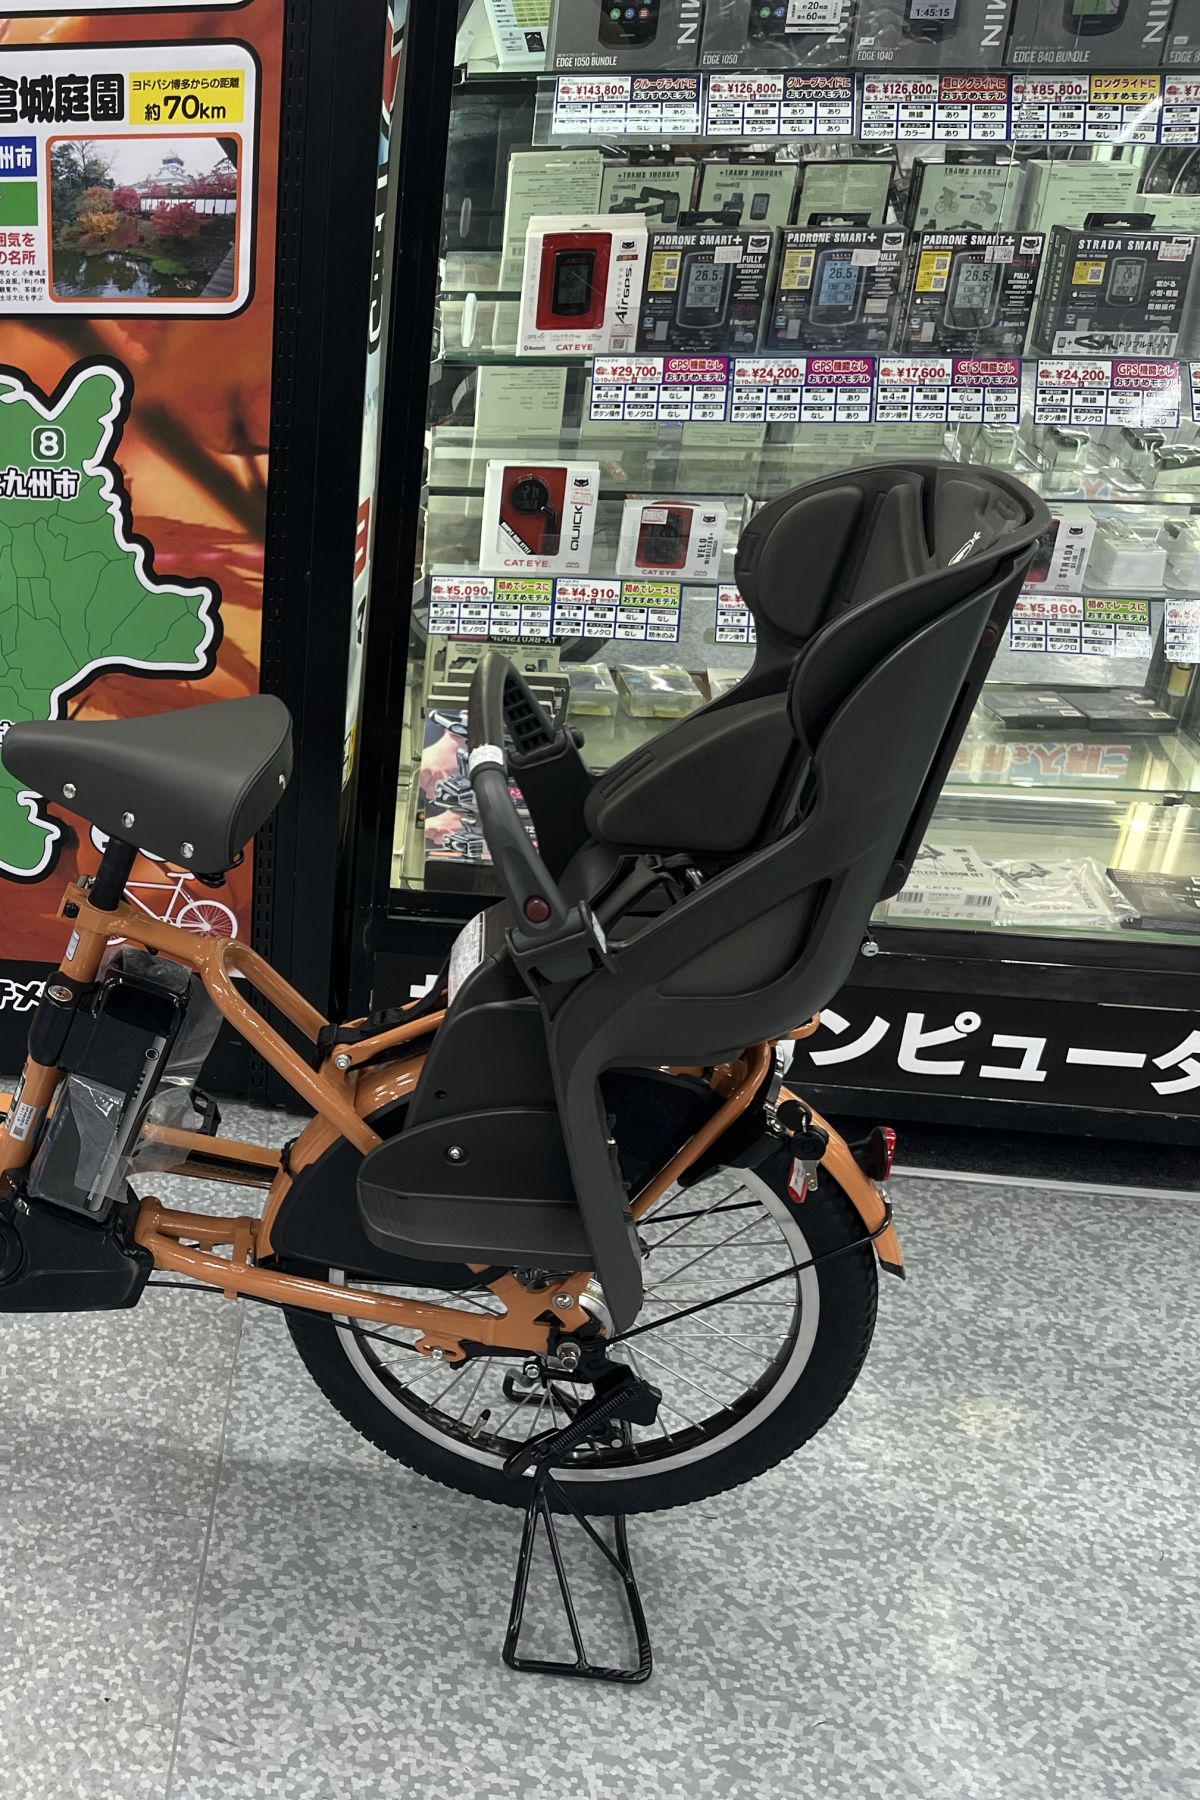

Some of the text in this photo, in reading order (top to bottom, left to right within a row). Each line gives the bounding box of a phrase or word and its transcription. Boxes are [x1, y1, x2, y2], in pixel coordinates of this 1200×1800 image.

[915, 7, 951, 17] 1:45:15
[702, 54, 738, 65] EDGE 1050
[857, 50, 894, 61] EDGE 1040
[1012, 50, 1090, 63] EDGE 840 BUNDLE
[556, 56, 618, 67] EDGE 1050 BUNDLE
[132, 76, 241, 92] ヨドバシ博多からの距離
[633, 78, 697, 90] グループライドに
[786, 77, 851, 88] グループライドに
[1093, 78, 1157, 89] ロングライドに
[633, 91, 697, 100] おすすめモデル
[786, 90, 851, 99] おすすめモデル
[941, 91, 1007, 101] おすすめモデル
[1092, 91, 1157, 101] おすすめモデル
[144, 95, 227, 121] 約70km
[653, 235, 697, 246] PADRONE
[787, 233, 831, 243] PADRONE
[923, 234, 968, 245] PADRONE
[1077, 240, 1162, 251] STRADA SMAR
[742, 255, 763, 263] FULLY
[556, 343, 593, 351] CATEYE
[666, 373, 726, 382] おすすめモデル
[808, 374, 870, 384] おすすめモデル
[40, 432, 59, 456] 8
[571, 505, 583, 551] QUICK
[503, 559, 549, 568] CATEYE
